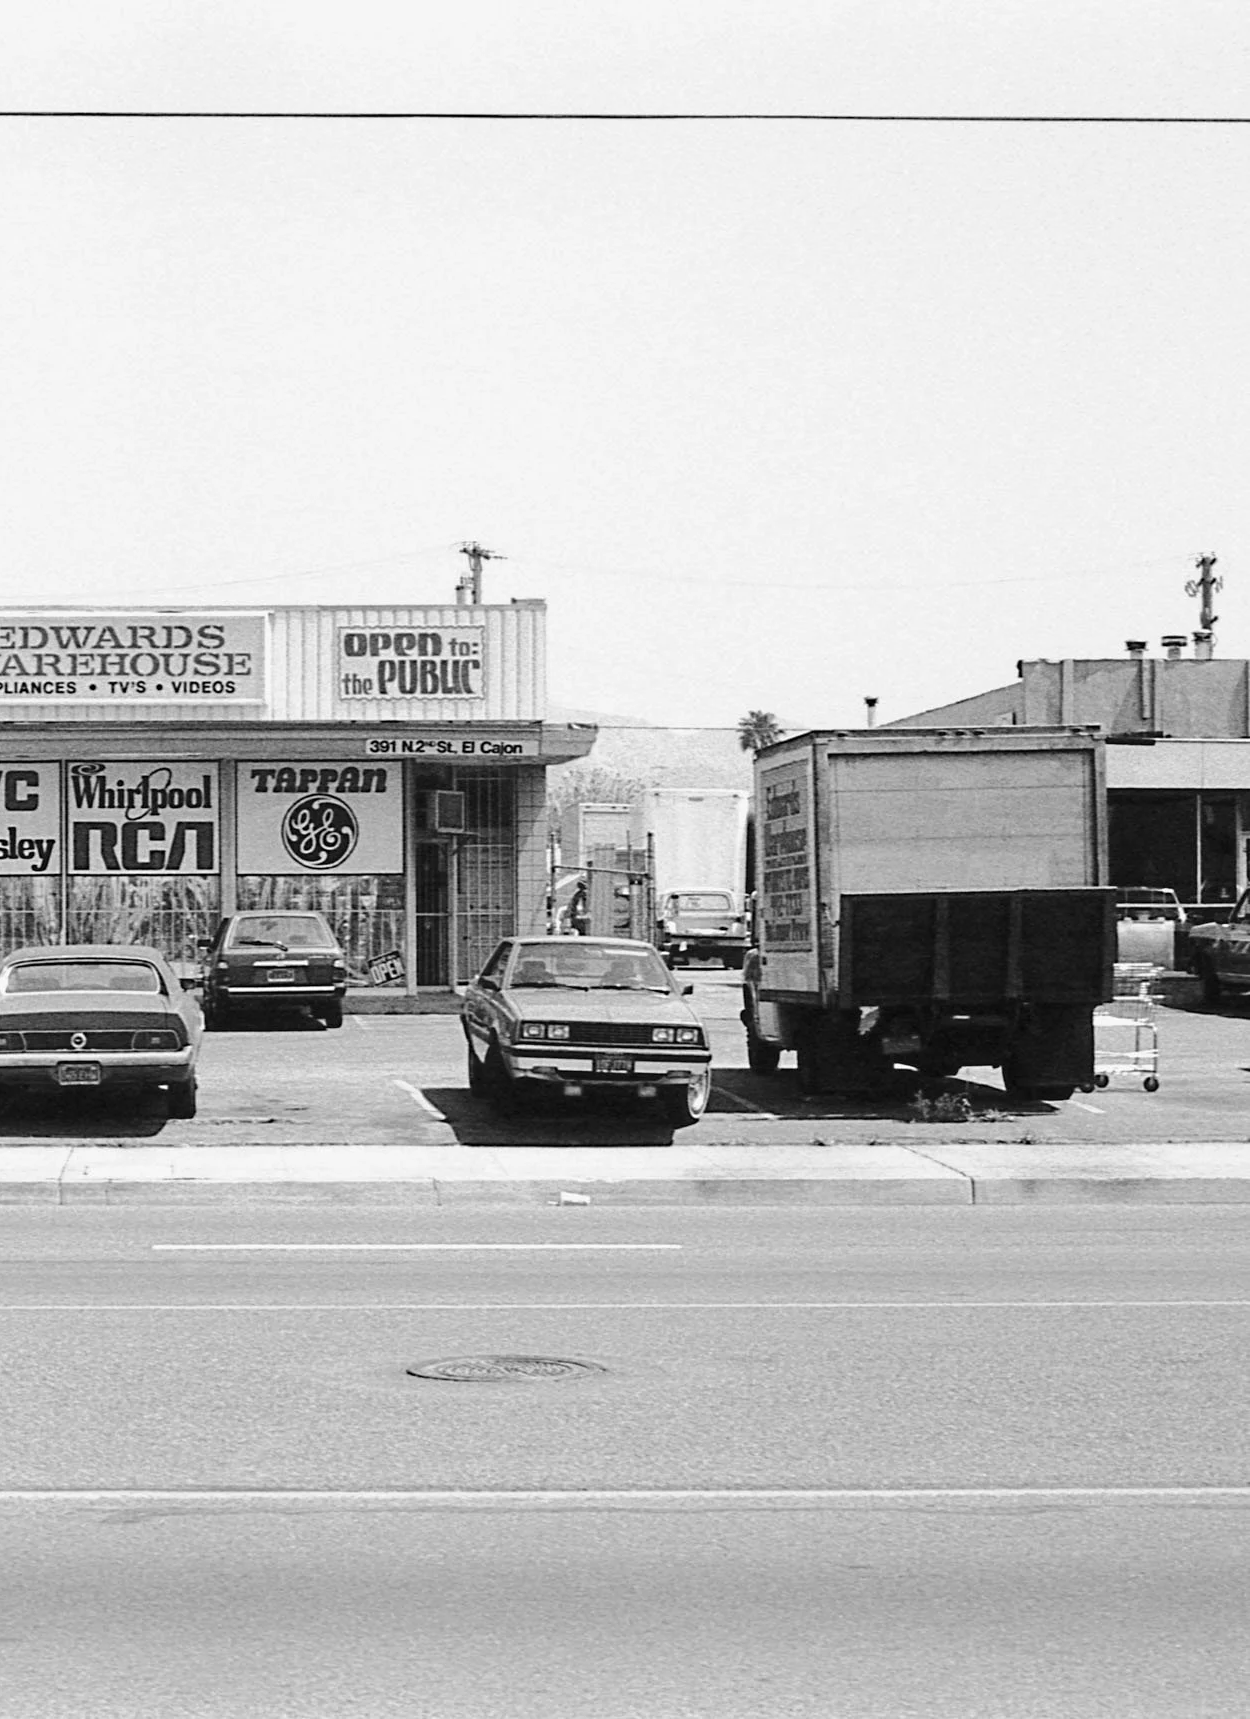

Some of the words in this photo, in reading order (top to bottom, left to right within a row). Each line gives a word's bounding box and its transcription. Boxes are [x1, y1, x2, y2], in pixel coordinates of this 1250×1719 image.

[448, 637, 479, 657] to:
[108, 681, 147, 694] TV'S
[171, 681, 236, 694] VIDEOS
[342, 673, 373, 695] the
[378, 659, 481, 695] PUBLIC
[369, 740, 396, 753] 391
[462, 741, 475, 754] El
[480, 741, 523, 756] Cajon
[71, 766, 213, 820] Whirlpool
[73, 821, 214, 871] RCA
